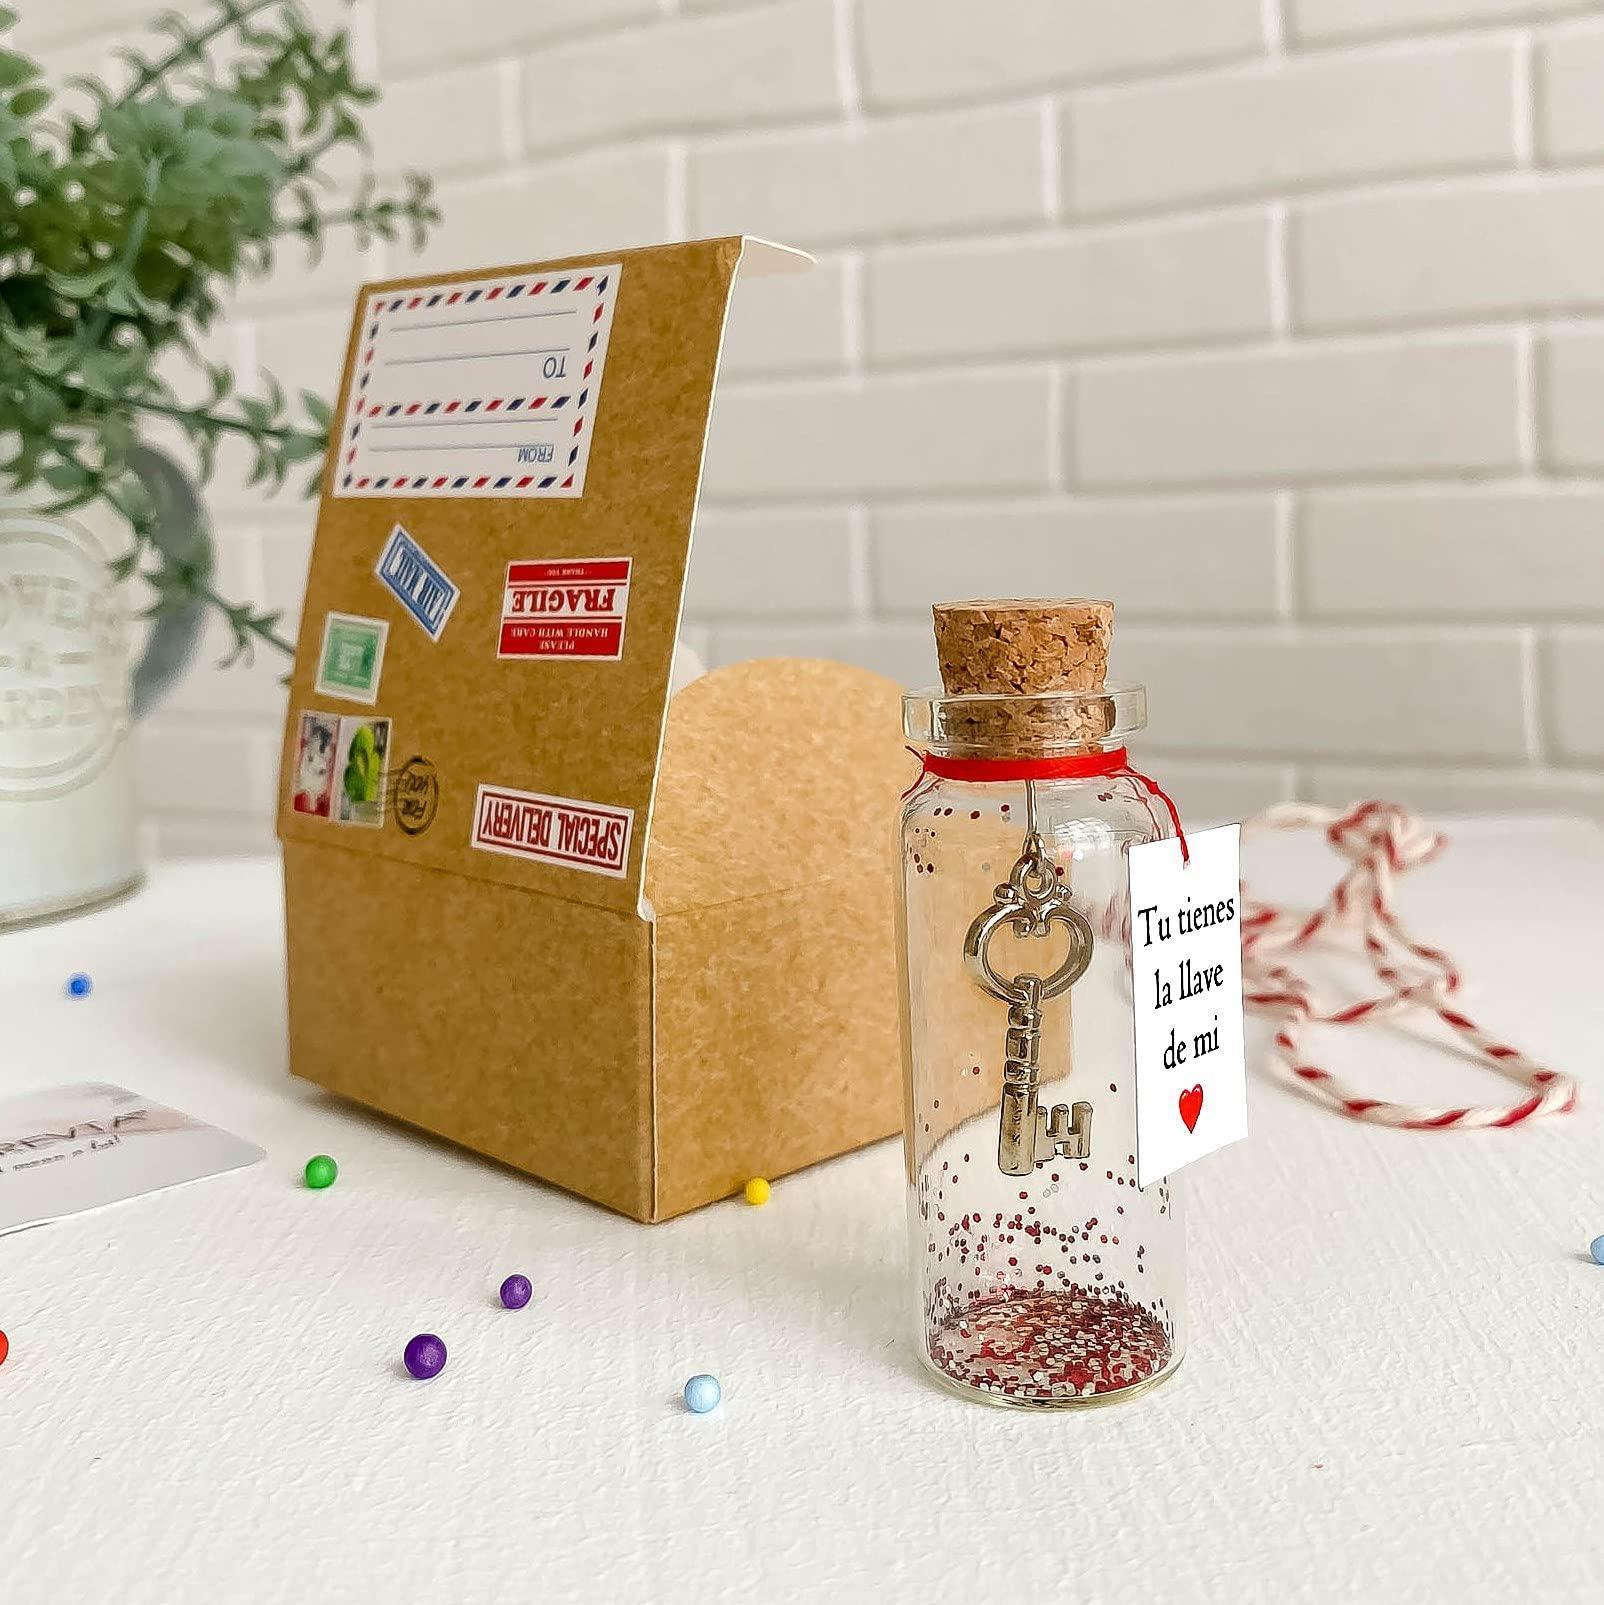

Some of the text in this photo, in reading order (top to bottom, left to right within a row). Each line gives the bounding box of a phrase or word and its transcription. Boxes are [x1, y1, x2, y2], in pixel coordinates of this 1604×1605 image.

[543, 356, 566, 378] TO
[518, 445, 554, 462] FROM
[511, 588, 616, 612] FRAGILE
[510, 627, 609, 638] HANDLE WITH CARE
[539, 639, 575, 650] PLEASE
[482, 799, 622, 861] SPECIAL DELIVERY
[1137, 896, 1235, 948] Tu tienes
[1154, 958, 1224, 1010] la llave
[1163, 1014, 1220, 1070] de mi
